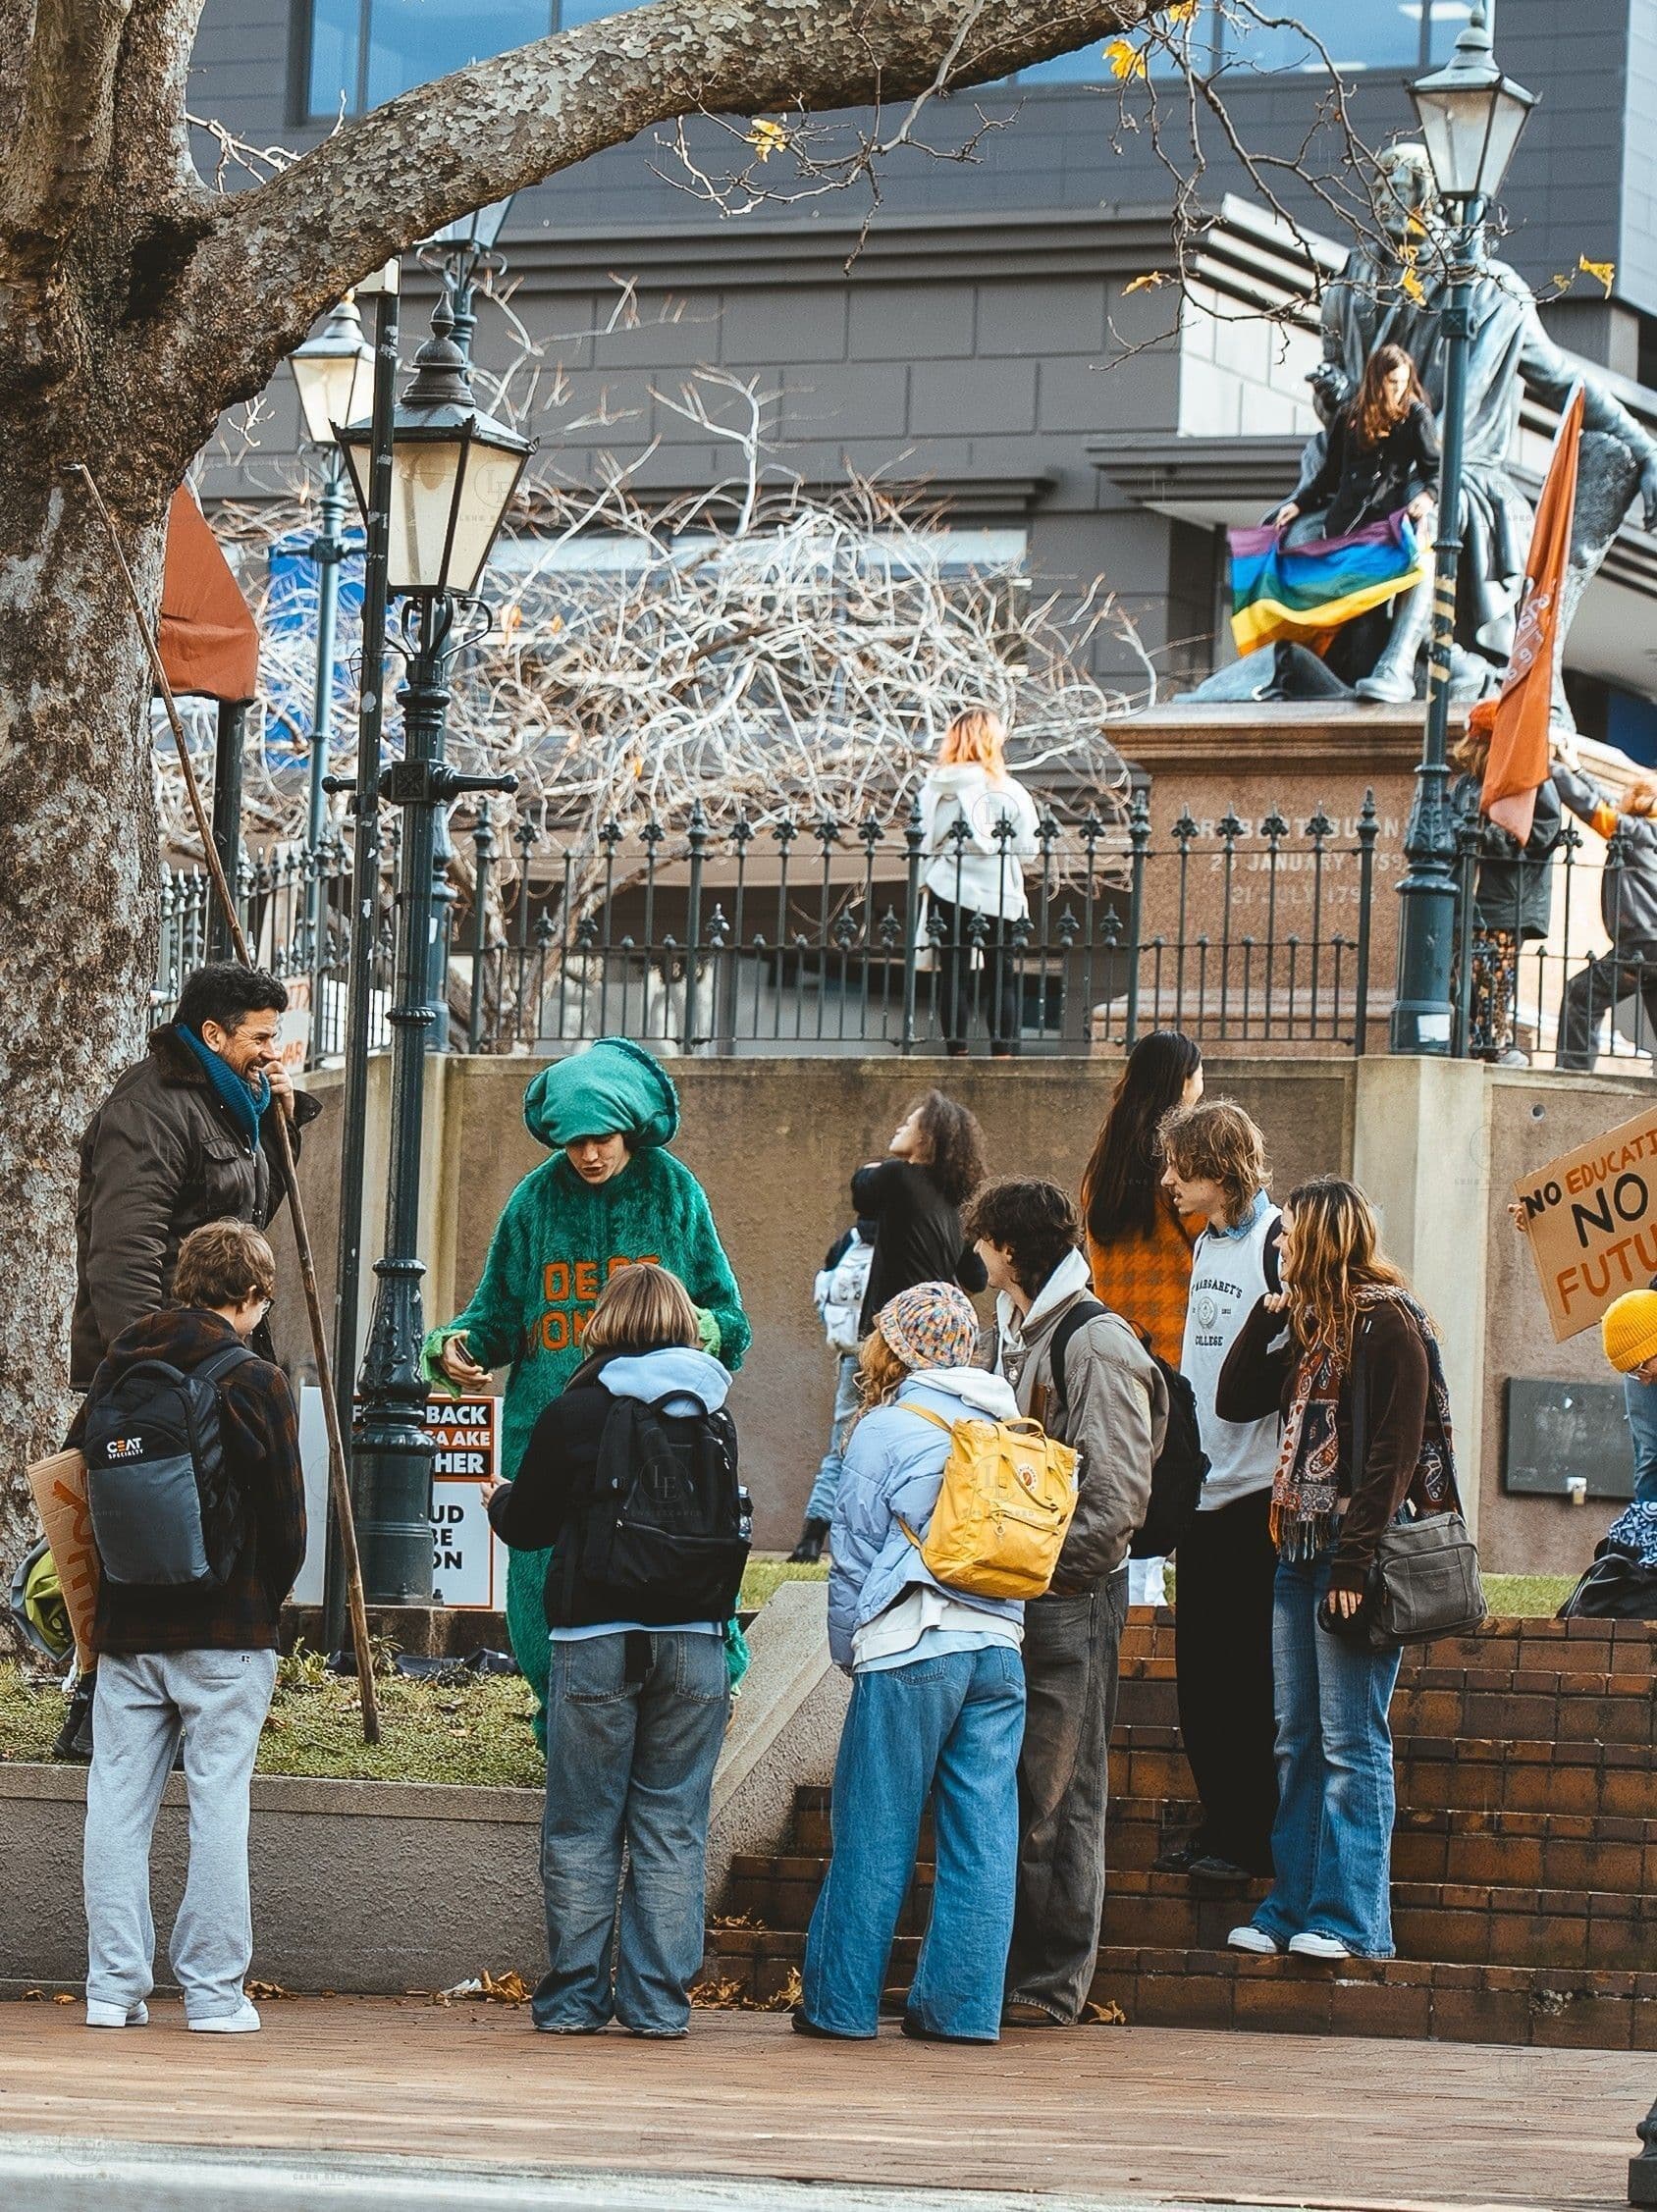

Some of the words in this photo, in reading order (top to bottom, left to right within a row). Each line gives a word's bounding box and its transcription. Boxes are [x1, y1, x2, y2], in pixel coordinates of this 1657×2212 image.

[1521, 1181, 1563, 1219] NO
[1572, 1173, 1649, 1248] NO
[1195, 1336, 1224, 1346] COLLEGE
[425, 1405, 487, 1425] BACK
[106, 1437, 142, 1453] CEAT
[452, 1431, 491, 1447] AKE
